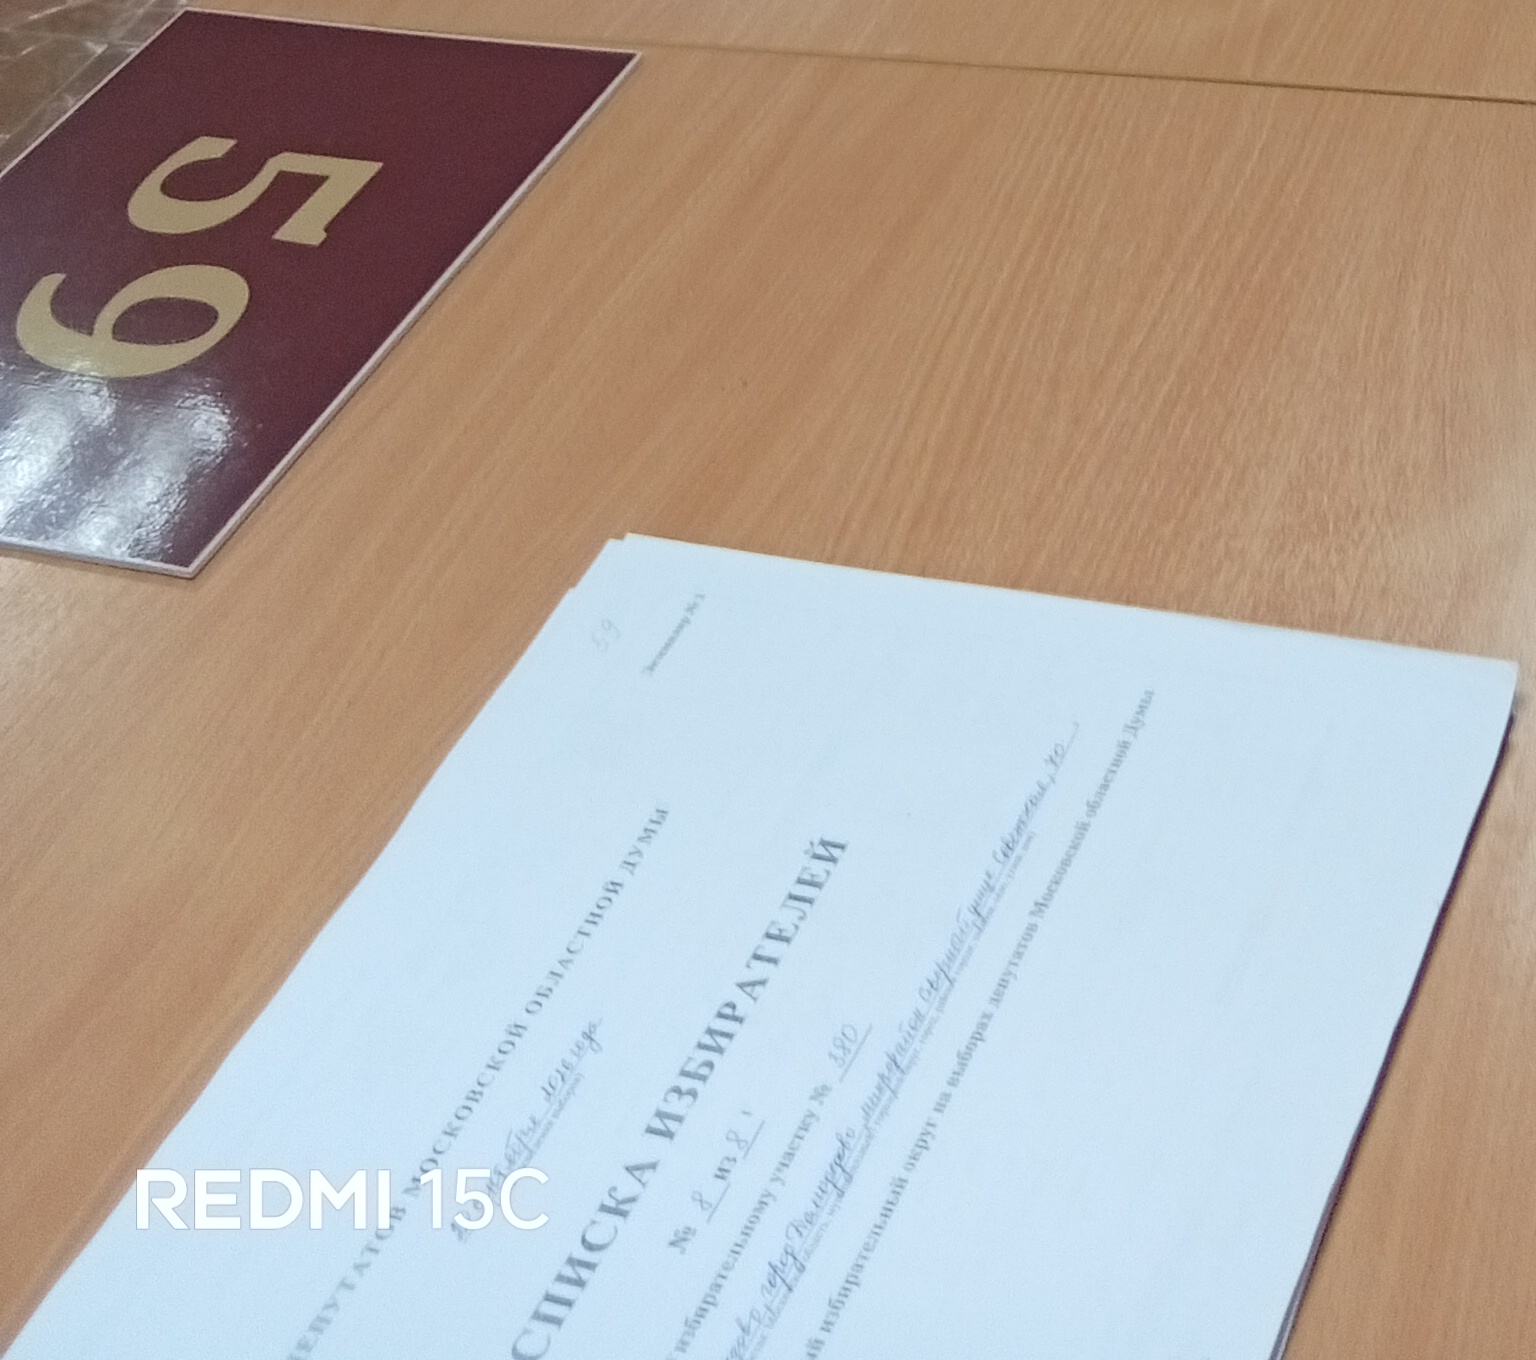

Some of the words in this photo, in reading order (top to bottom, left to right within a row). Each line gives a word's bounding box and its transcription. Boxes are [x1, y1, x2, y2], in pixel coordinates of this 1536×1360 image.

[15, 136, 383, 378] 59
[403, 1024, 527, 1196] МОСКОВСКОЙ
[525, 881, 624, 1014] ОБЛАСТНОЙ
[619, 809, 668, 875] ДУМЫ
[512, 1162, 658, 1360] СПИСКА
[646, 840, 849, 1139] ИЗБИРАТЕЛЕЙ
[820, 1177, 908, 1332] избирательный
[904, 1118, 937, 1172] округ
[932, 1091, 952, 1115] на
[946, 1012, 993, 1087] выборах
[989, 922, 1042, 1008] депутатов
[1029, 821, 1091, 918] Московской
[1086, 740, 1131, 818] областной
[1122, 689, 1158, 738] Думы
[667, 1226, 697, 1255] №
[714, 1156, 737, 1181] из
[675, 1190, 776, 1352] избирательному
[769, 1109, 820, 1186] участку
